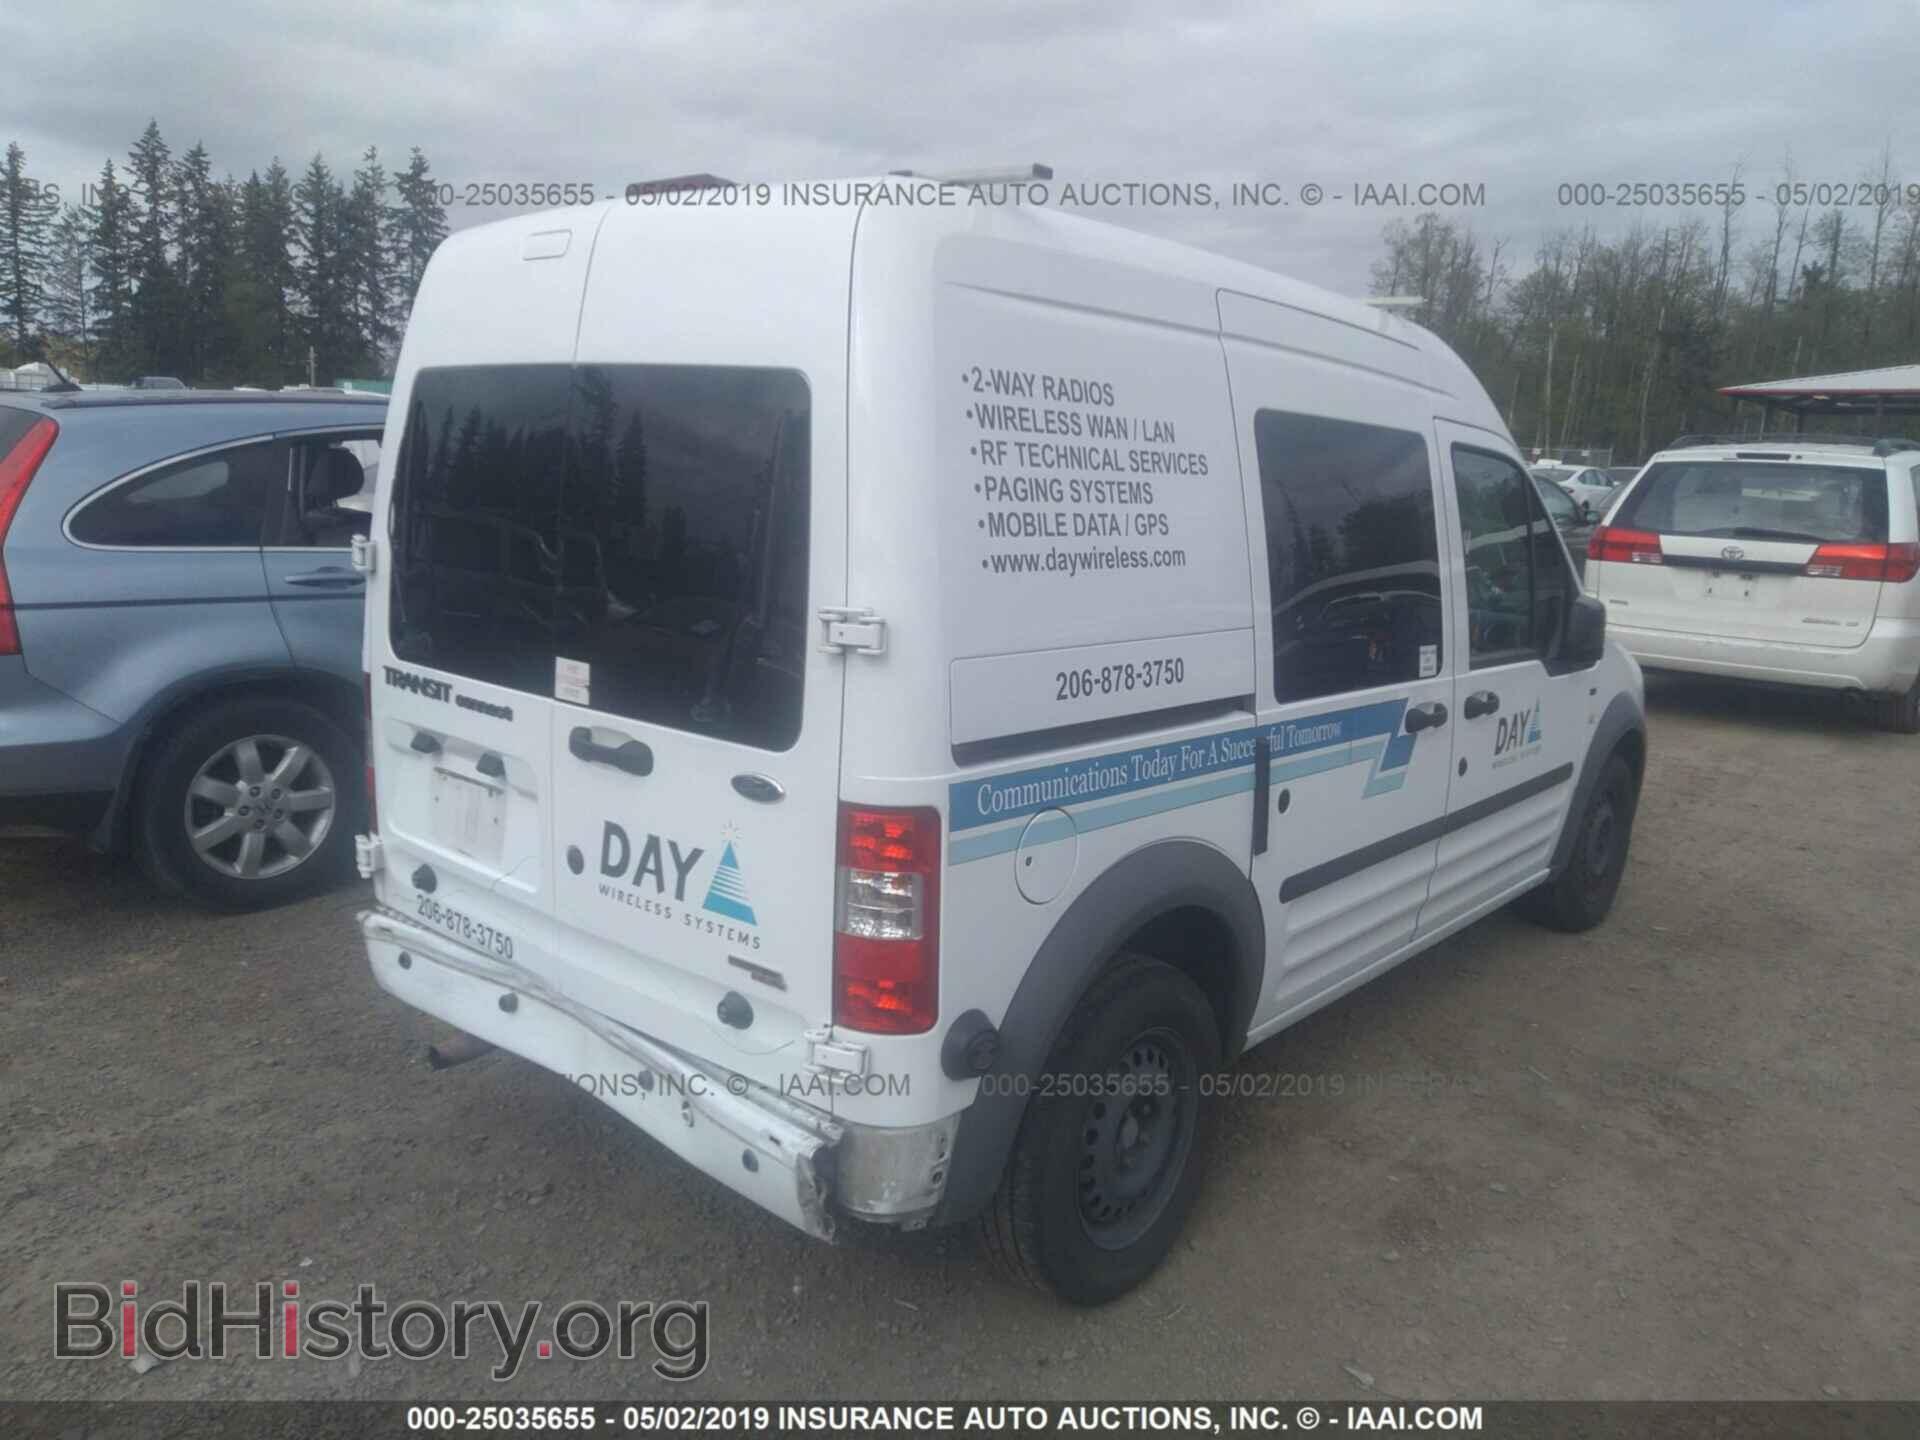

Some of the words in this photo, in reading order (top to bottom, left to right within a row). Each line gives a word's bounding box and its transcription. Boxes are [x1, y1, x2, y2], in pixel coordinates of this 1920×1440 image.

[971, 366, 1035, 398] 2-WAY
[1042, 375, 1115, 407] RADIOS
[975, 403, 1082, 437] WIRELESS
[1087, 413, 1128, 441] WAN
[1142, 420, 1175, 443] LAN
[980, 439, 1008, 466] RF
[1014, 442, 1125, 473] TECHNICAL
[1129, 449, 1209, 476] SERVICES
[984, 476, 1063, 503] PAGING
[1069, 478, 1154, 505] SYSTEMS
[988, 511, 1068, 538] MOBILE
[1073, 512, 1121, 537] DATA
[1134, 513, 1169, 536] GPS
[991, 546, 1186, 578] www.daywireless.com
[1055, 656, 1185, 701] 206-878-3750
[1494, 709, 1531, 755] DAY
[977, 761, 1128, 816] Communications
[1130, 749, 1177, 782] Today
[1180, 745, 1205, 772] For
[1207, 741, 1218, 765] A
[1220, 724, 1285, 762] Succeful
[1286, 720, 1343, 749] Tomorrow
[600, 820, 705, 902] DAY
[417, 894, 513, 959] 206-878-3750
[598, 883, 672, 919] WIRELESS
[684, 913, 761, 950] SYSTEMS
